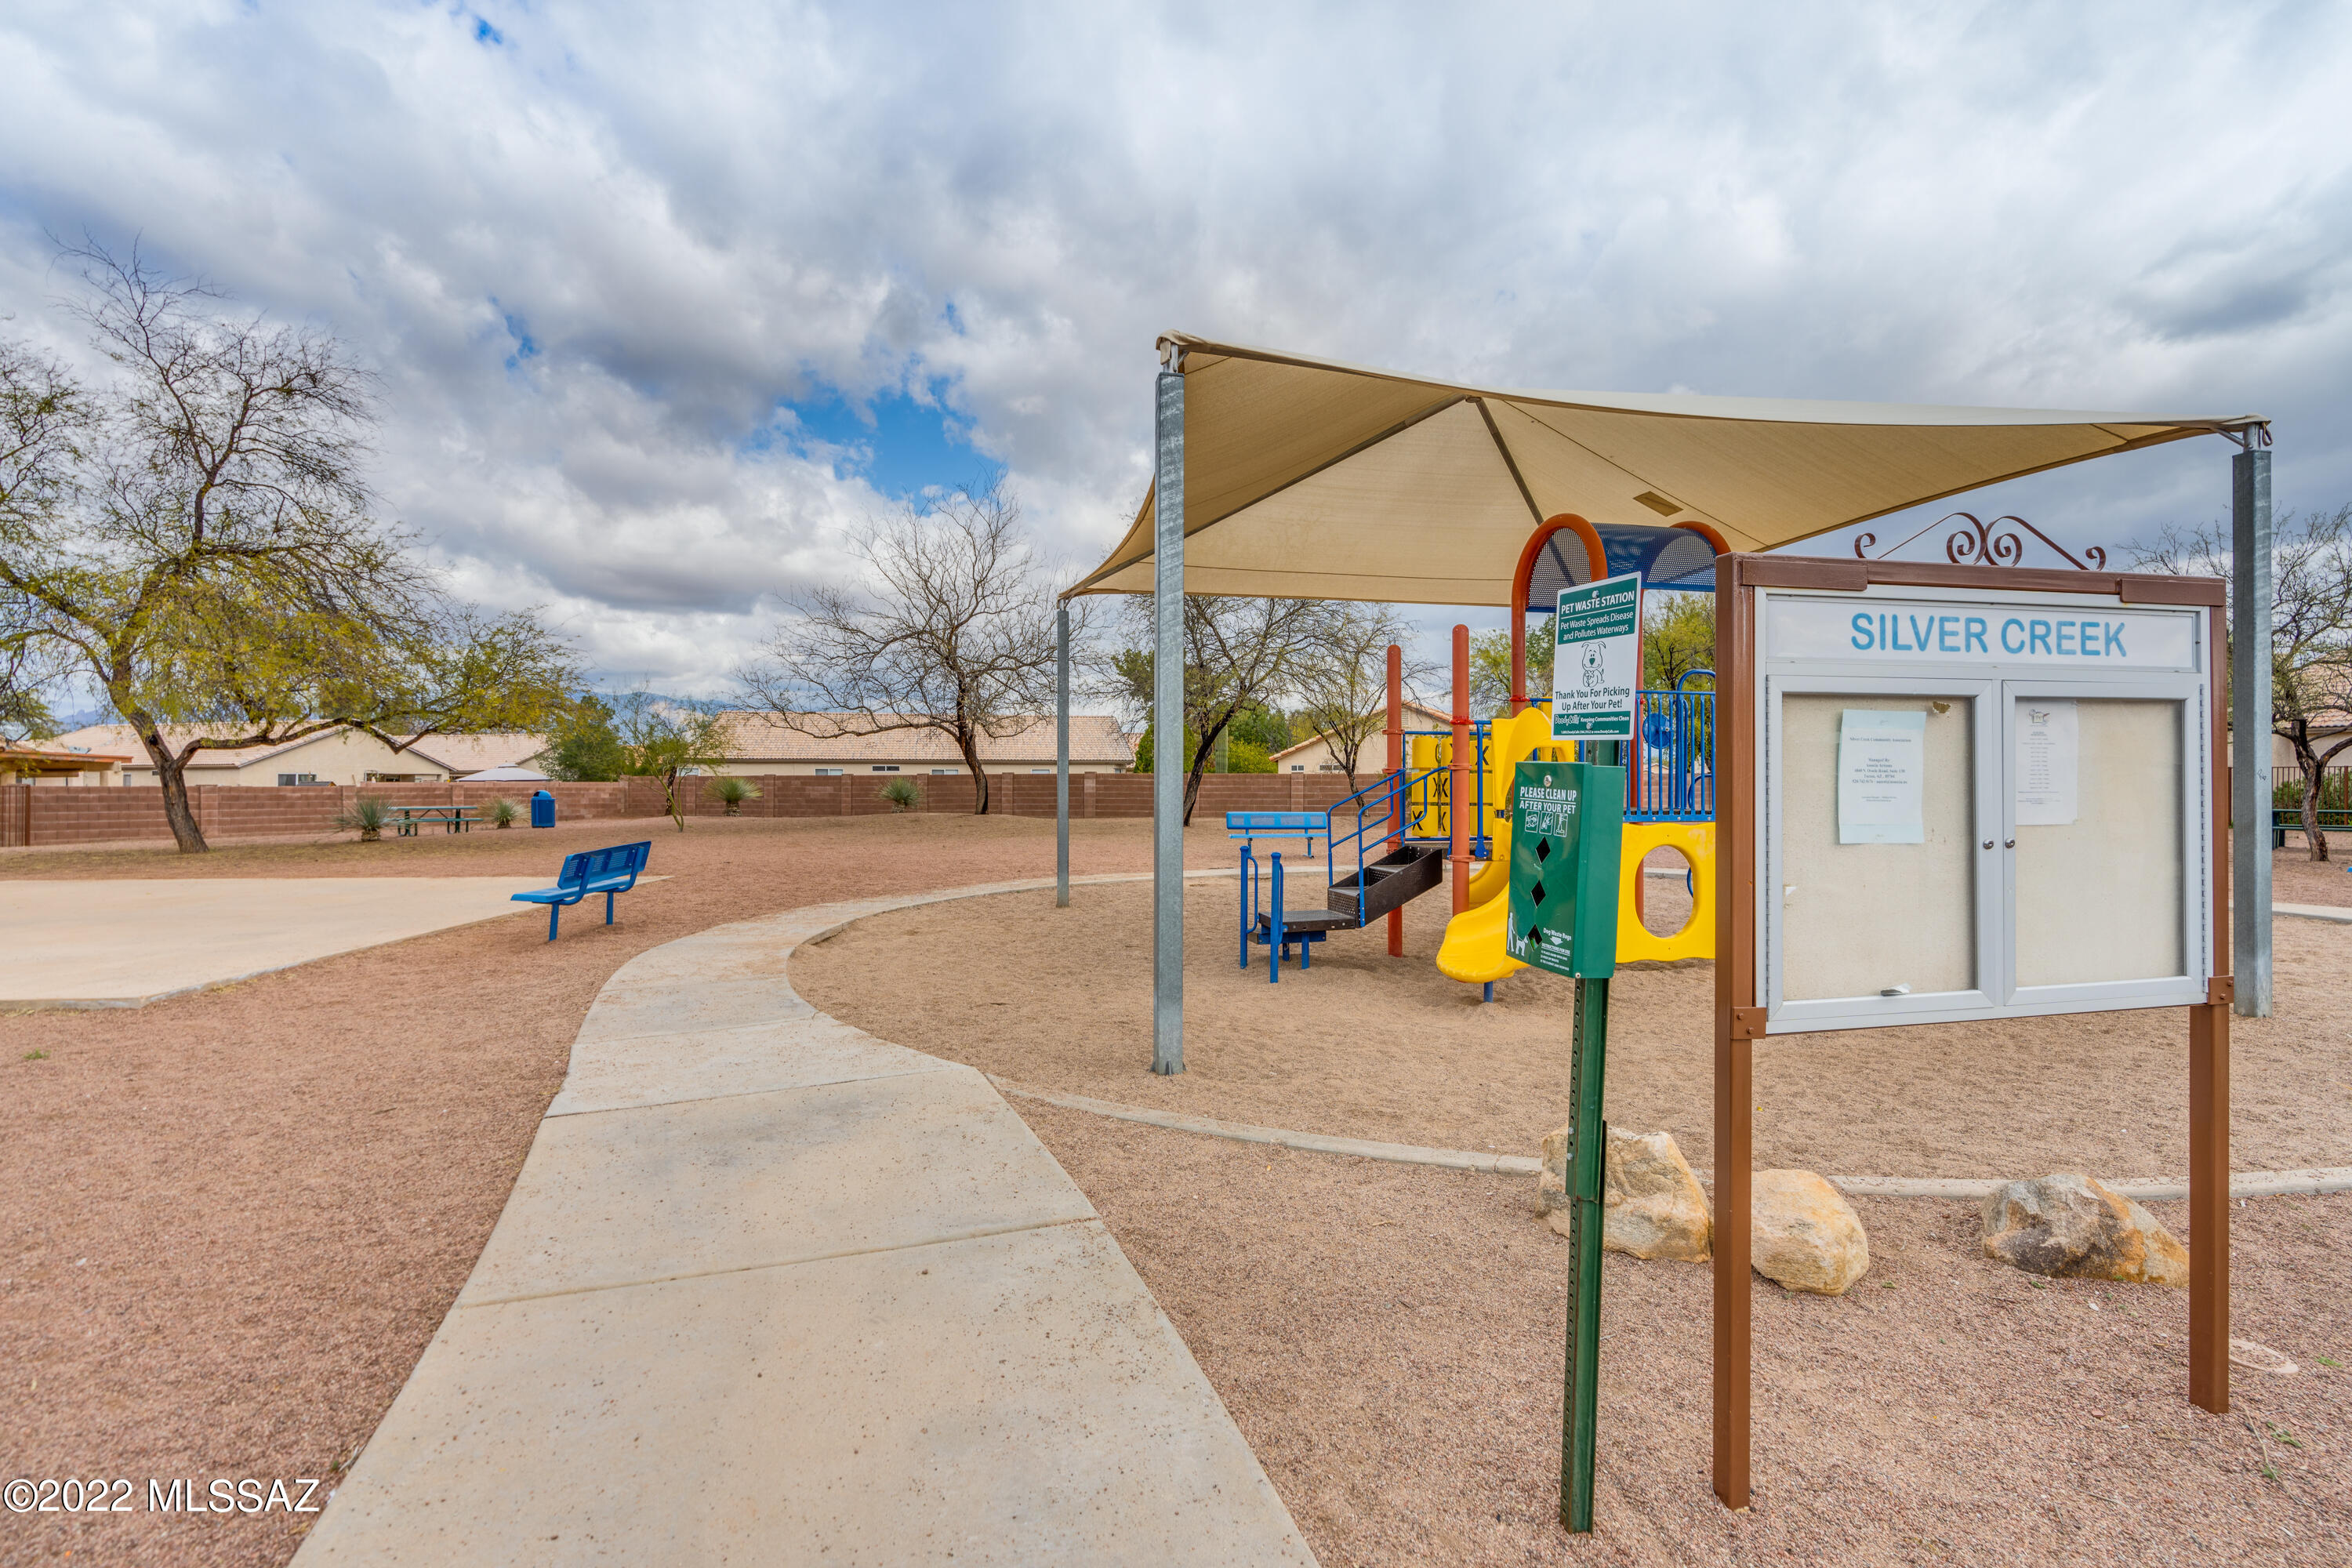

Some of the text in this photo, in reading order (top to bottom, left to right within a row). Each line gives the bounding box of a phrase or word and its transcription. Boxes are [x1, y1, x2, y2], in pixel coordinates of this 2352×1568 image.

[1561, 590, 1635, 615] PET WASTE STATION
[1560, 611, 1634, 630] Pet Waste Spreads Disease
[1563, 624, 1629, 641] and Pollutes Waterways
[1850, 612, 2128, 657] SILVER CREEK
[1555, 686, 1630, 700] Thank You For Picking
[1562, 699, 1622, 713] Up After Your Pet!
[1520, 786, 1577, 801] PLEASE CLEAN UP
[1519, 800, 1576, 814] AFTER YOUR PET
[1562, 933, 1572, 941] Bags
